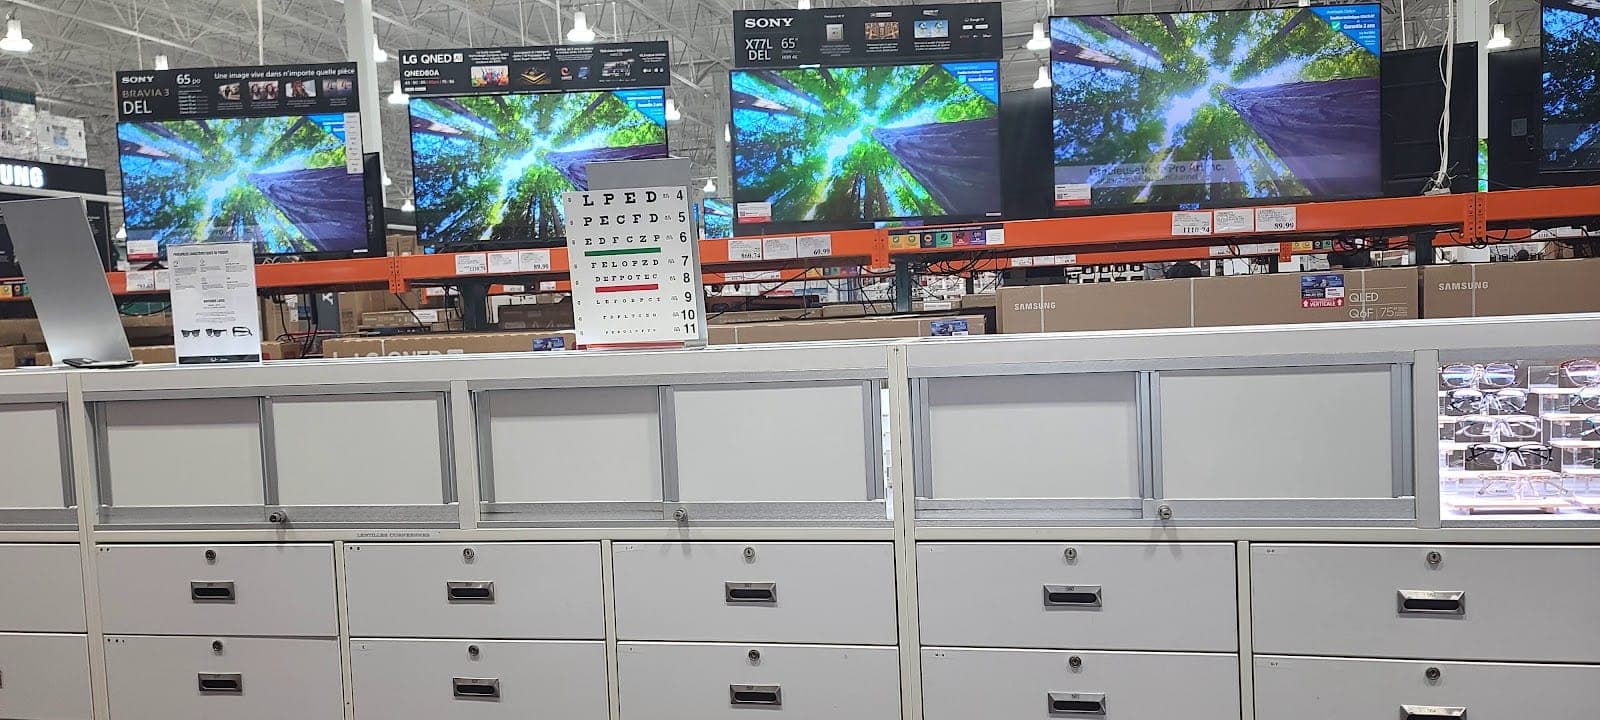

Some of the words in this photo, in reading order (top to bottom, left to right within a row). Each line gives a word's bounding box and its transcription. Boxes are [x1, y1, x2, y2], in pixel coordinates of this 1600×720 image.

[744, 18, 794, 28] SONY
[745, 38, 773, 50] X77L
[402, 54, 418, 64] LG
[421, 54, 452, 64] QNED
[748, 50, 771, 60] DEL
[122, 76, 154, 84] SONY
[176, 74, 191, 84] 65
[229, 71, 249, 80] image
[316, 68, 336, 76] quelle
[122, 88, 162, 98] BRAVIA
[123, 99, 152, 114] DEL
[1168, 164, 1185, 172] Pro
[582, 194, 594, 206] L
[603, 193, 614, 205] P
[624, 192, 636, 204] E
[645, 191, 657, 203] D
[676, 190, 683, 200] 4
[583, 217, 592, 226] P
[600, 216, 609, 225] E
[616, 215, 625, 224] C
[632, 214, 641, 223] F
[649, 214, 658, 223] D
[678, 211, 686, 222] 5
[680, 232, 687, 242] 6
[682, 256, 689, 266] 7
[683, 272, 690, 283] 8
[1438, 281, 1489, 291] SAMSUNG
[685, 292, 691, 302] 9
[1349, 292, 1378, 302] QLED
[1014, 302, 1056, 311] SAMSUNG
[681, 309, 695, 320] 10
[1349, 308, 1374, 318] Q6F
[684, 323, 695, 334] 11
